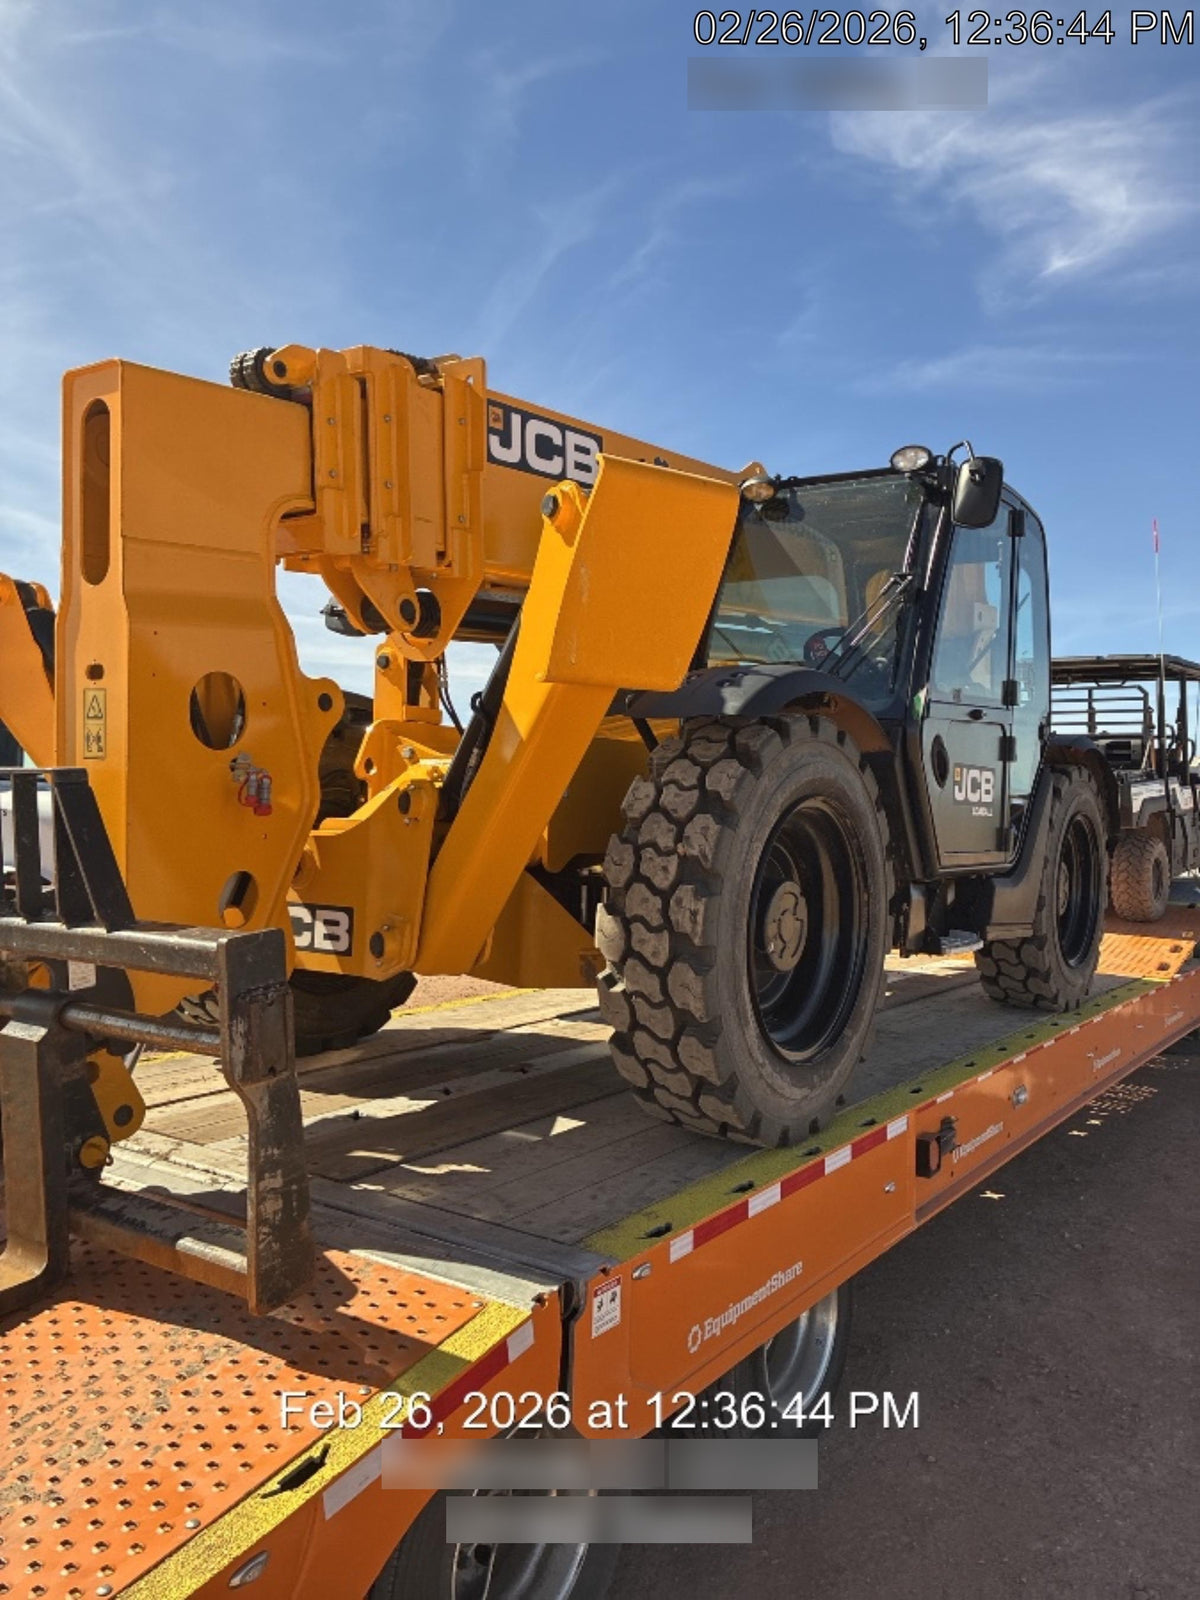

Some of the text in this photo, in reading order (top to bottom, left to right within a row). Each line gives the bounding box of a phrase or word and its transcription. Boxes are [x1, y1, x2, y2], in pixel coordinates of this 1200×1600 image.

[488, 411, 600, 485] JCB
[954, 767, 994, 803] JCB
[287, 906, 350, 952] CB
[703, 1261, 803, 1341] EquipmentShare
